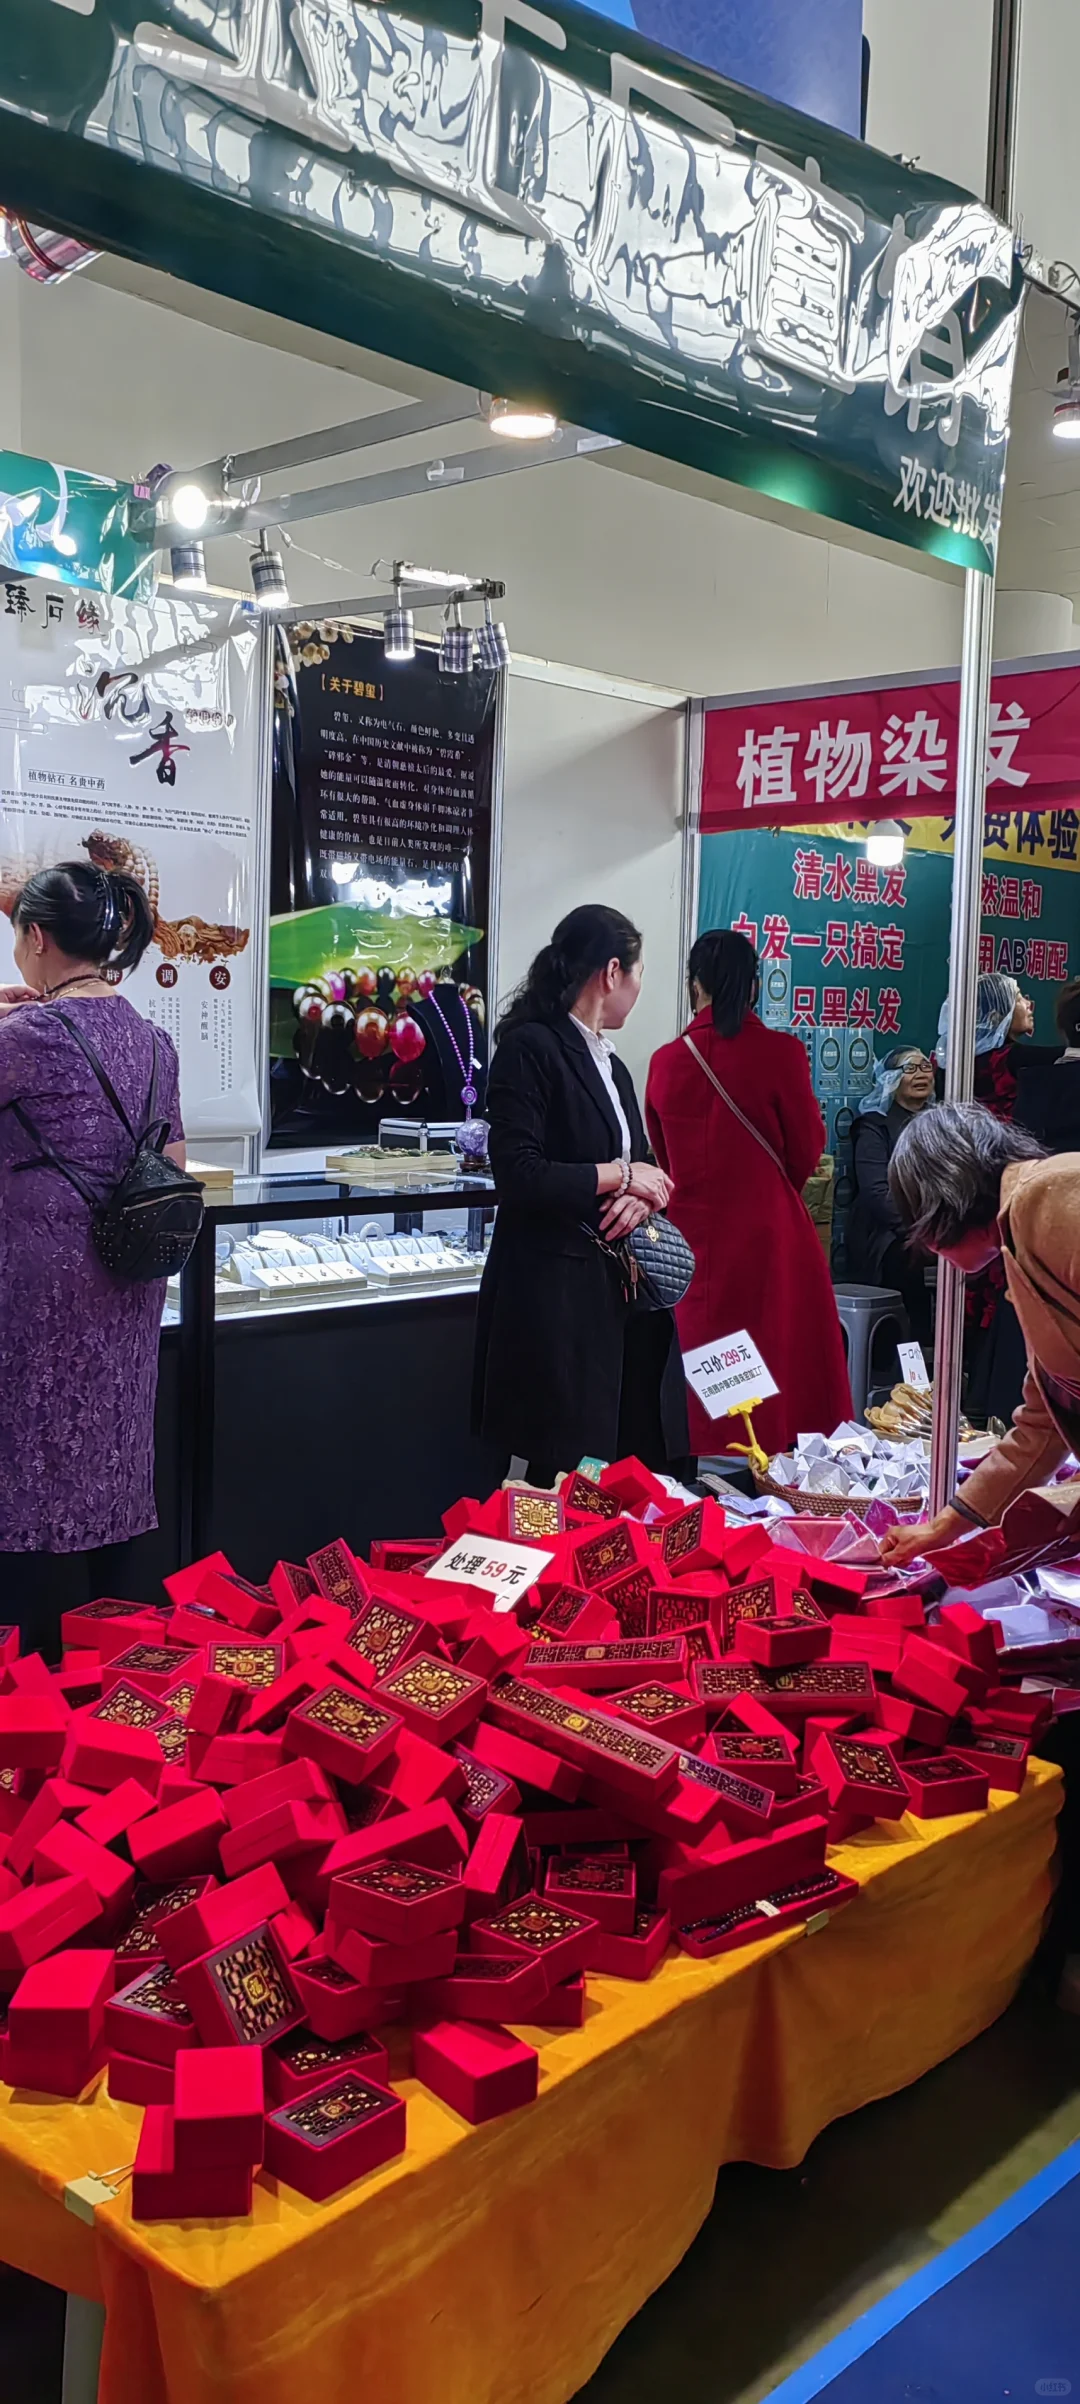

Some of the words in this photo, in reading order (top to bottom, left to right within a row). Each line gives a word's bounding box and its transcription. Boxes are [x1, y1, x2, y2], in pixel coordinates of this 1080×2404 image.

[736, 701, 1031, 808] 植物染发
[792, 849, 907, 907] 清水黑发
[791, 986, 902, 1034] 只黑头发
[444, 1552, 528, 1584] 处理59元
